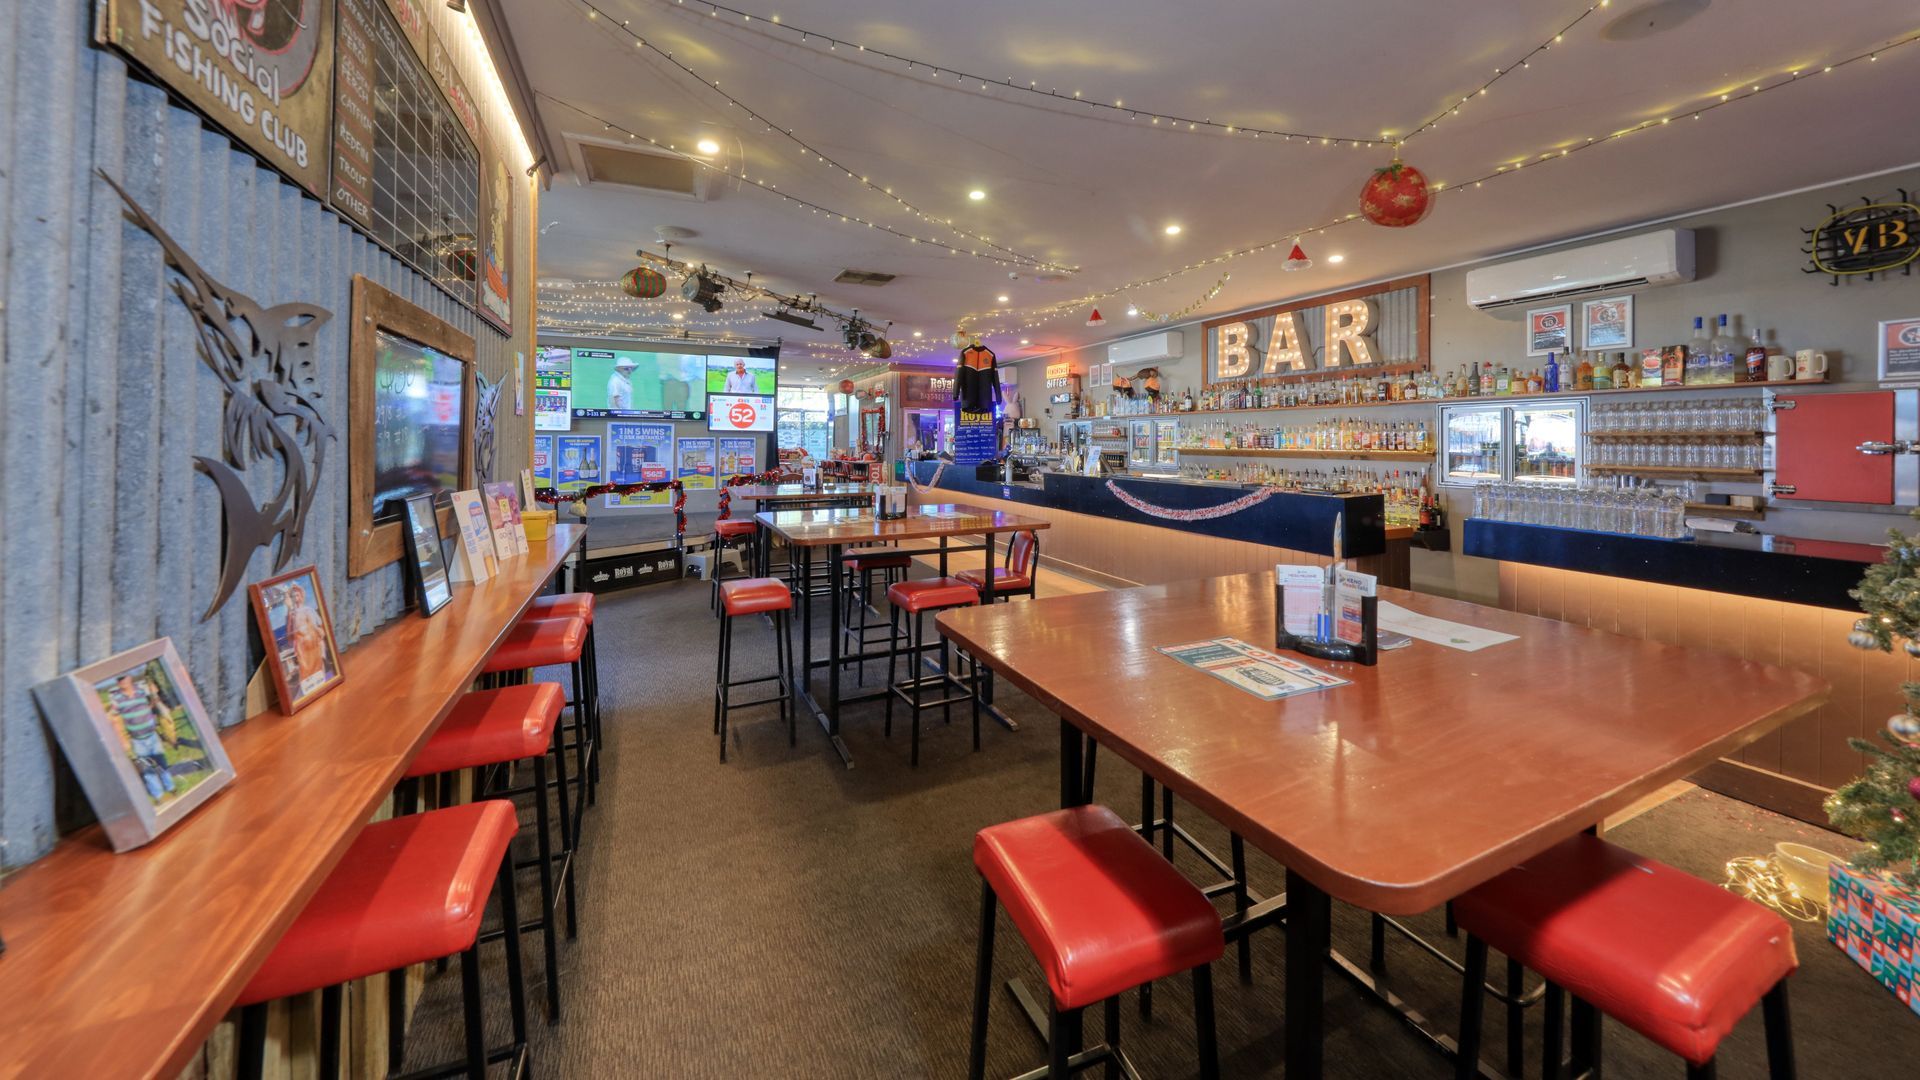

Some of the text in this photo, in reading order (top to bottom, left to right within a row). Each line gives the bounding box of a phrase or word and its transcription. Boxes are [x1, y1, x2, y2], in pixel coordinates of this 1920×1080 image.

[183, 0, 280, 107] Social
[141, 0, 308, 168] FISHING CLUB
[340, 94, 372, 133] CATFISH
[339, 122, 369, 164] REDFIN
[338, 156, 368, 189] TROUT
[336, 187, 369, 220] OTHER
[1843, 219, 1908, 256] VB
[1217, 298, 1377, 379] BAR
[930, 377, 955, 391] Royal
[1046, 377, 1067, 389] BITTER
[641, 428, 665, 436] WINS
[731, 408, 754, 423] 52
[614, 565, 634, 579] Royal
[658, 558, 675, 571] Royal
